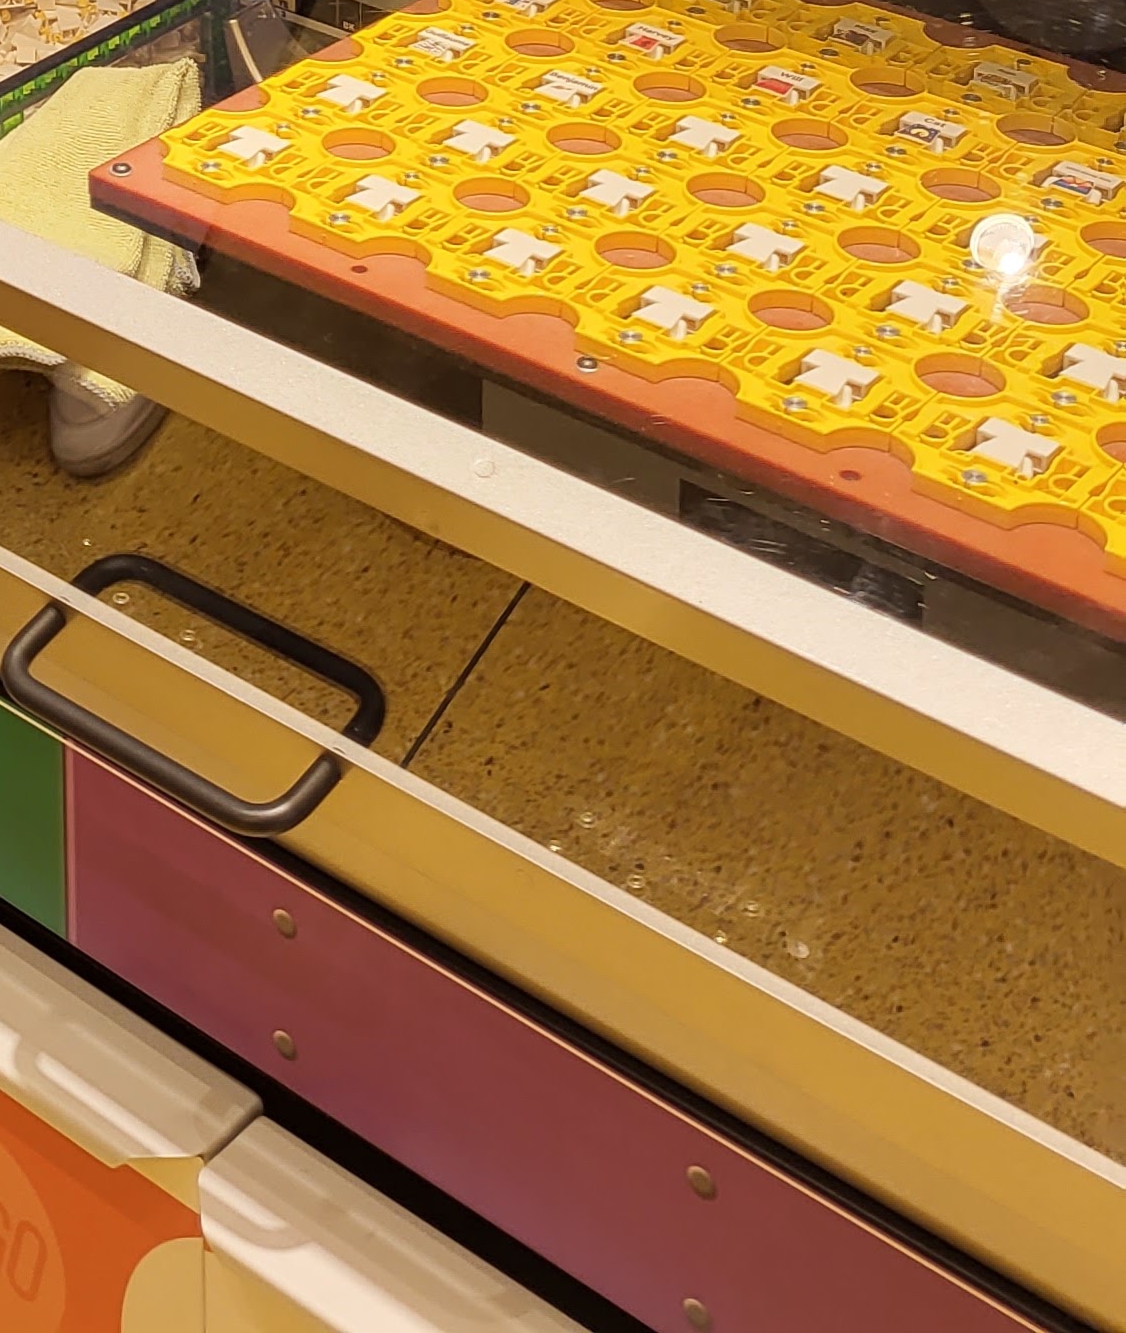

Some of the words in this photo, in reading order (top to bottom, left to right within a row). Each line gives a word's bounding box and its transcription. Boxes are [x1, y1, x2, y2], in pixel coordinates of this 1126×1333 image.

[637, 25, 676, 41] Harvey
[549, 71, 599, 91] Benjamin
[780, 71, 805, 83] Will
[924, 117, 947, 129] Cat
